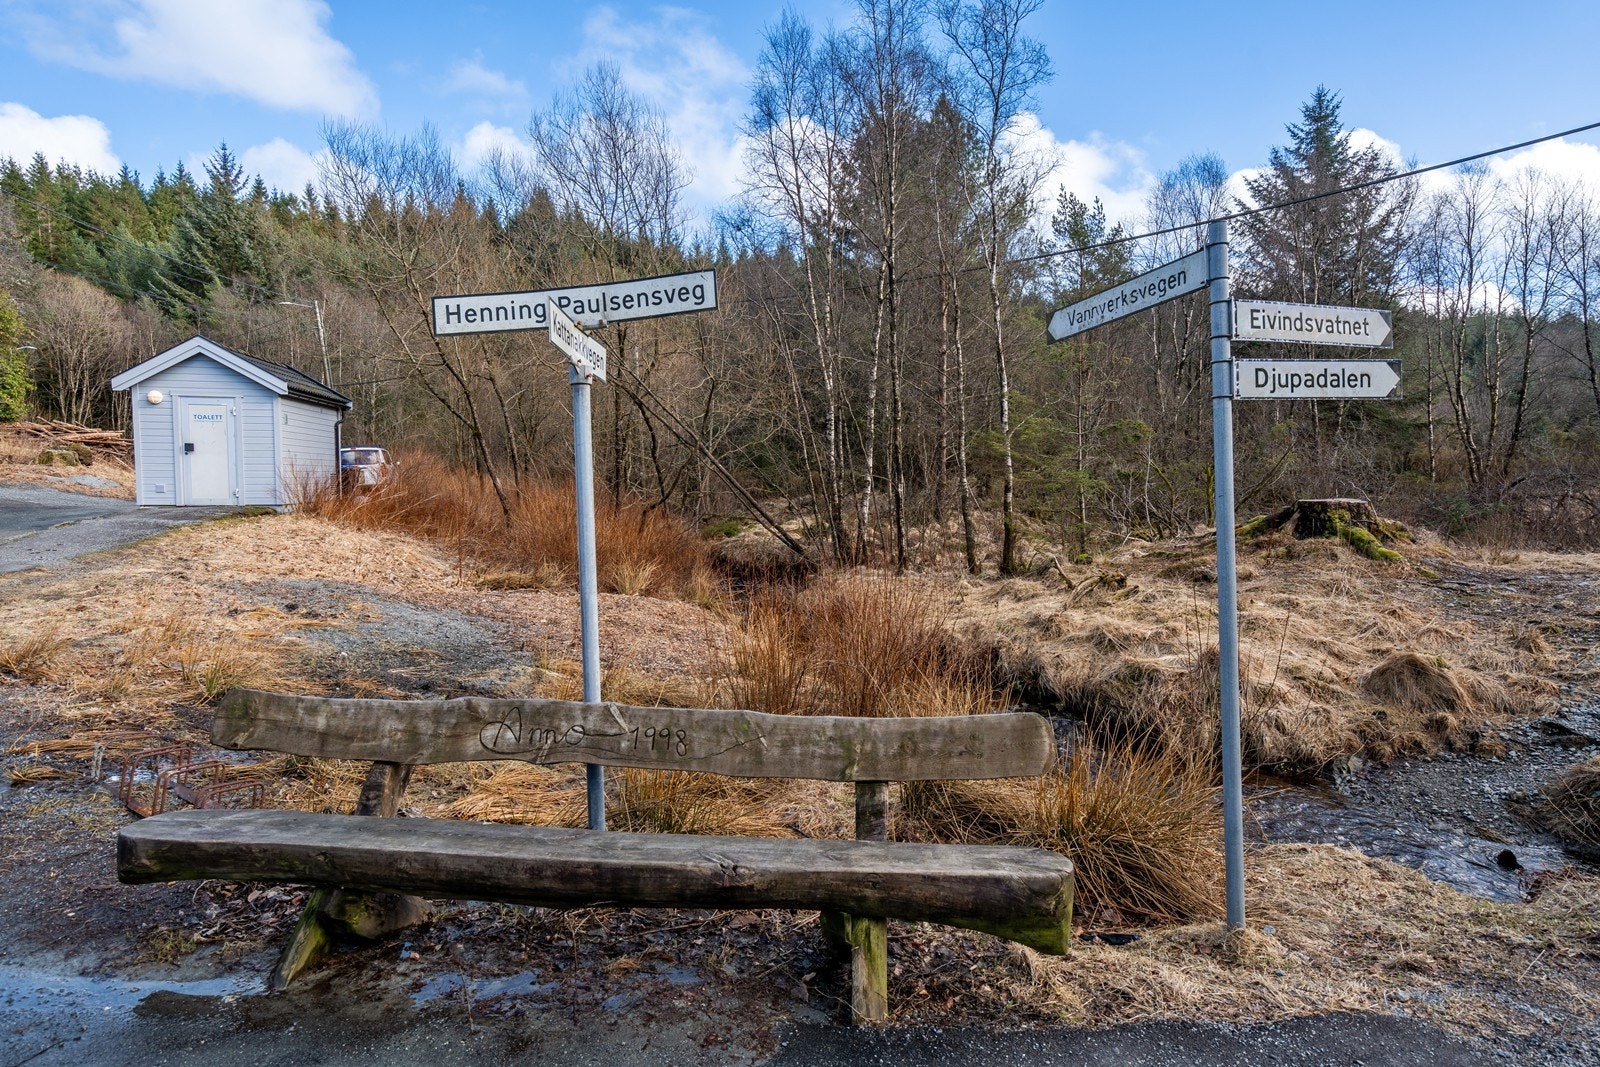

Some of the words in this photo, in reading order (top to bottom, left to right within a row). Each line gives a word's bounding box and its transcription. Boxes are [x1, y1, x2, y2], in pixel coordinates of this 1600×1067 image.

[445, 300, 547, 324] Henning
[558, 283, 705, 315] Paulsensveg
[1067, 270, 1187, 326] Vannverksvegen
[552, 310, 604, 371] Kattanakkvegen
[1250, 308, 1370, 337] Eivindsvatnet
[1254, 366, 1372, 394] Djupadalen
[628, 726, 688, 757] 1998
